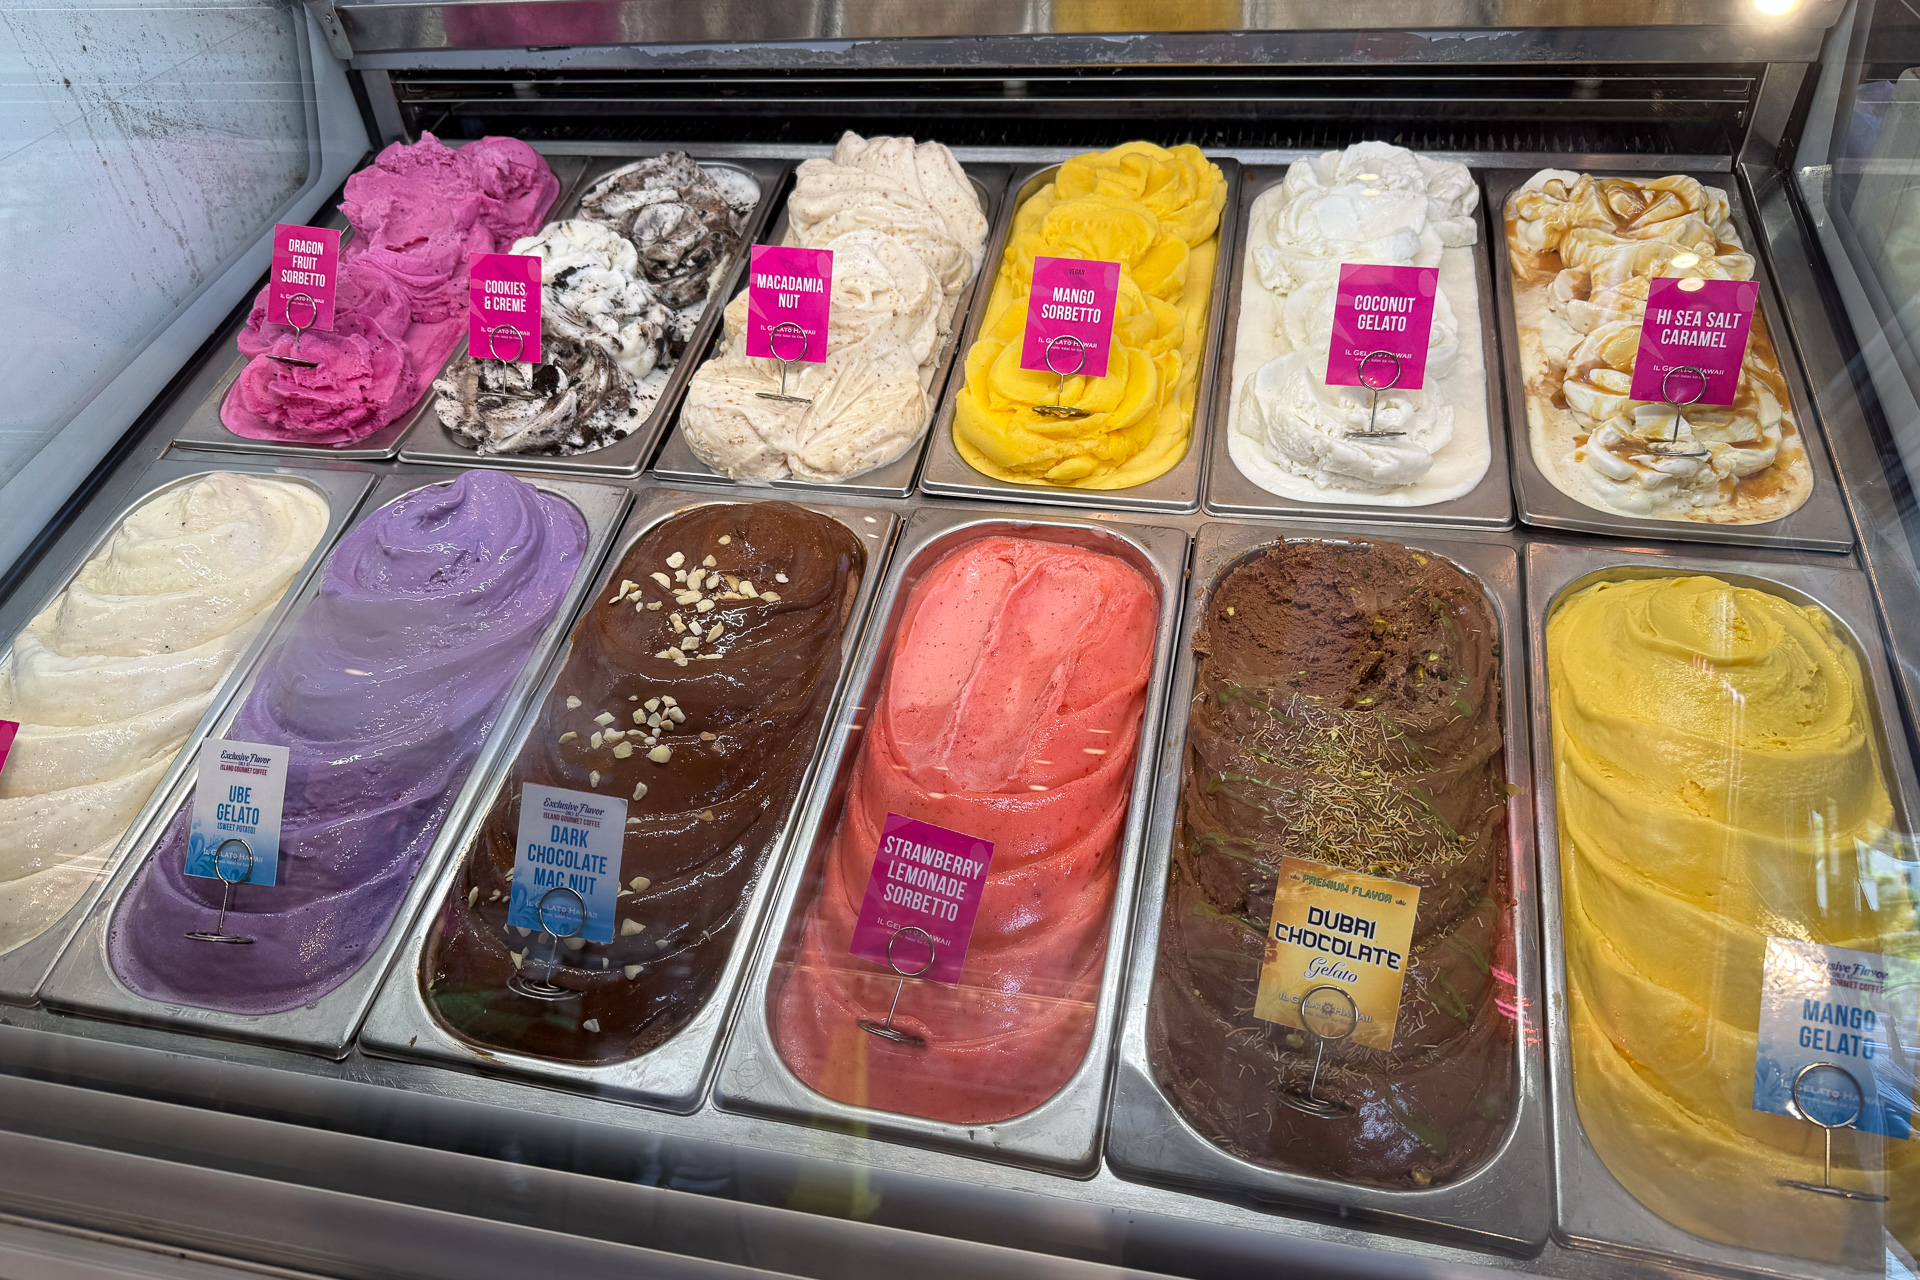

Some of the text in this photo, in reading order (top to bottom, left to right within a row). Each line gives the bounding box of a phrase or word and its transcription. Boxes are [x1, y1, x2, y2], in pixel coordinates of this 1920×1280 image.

[288, 238, 324, 256] DRAGON
[292, 254, 318, 270] FRUIT
[281, 270, 326, 287] SORBETTO
[1069, 268, 1086, 276] VEGAN
[485, 280, 526, 296] COOKIES
[757, 274, 824, 293] MACADAMIA
[484, 296, 526, 313] & CREME
[778, 293, 800, 309] NUT
[1052, 287, 1095, 305] MANGO
[1354, 295, 1416, 313] COCONUT
[1041, 304, 1101, 324] SORBETTO
[1357, 314, 1406, 332] GELATO
[1656, 309, 1742, 329] HI SEA SALT
[1661, 329, 1727, 348] CARAMEL
[220, 750, 271, 765] Exclusive Flavor
[229, 785, 252, 804] UBE
[216, 803, 260, 826] GELATO
[543, 797, 604, 816] Exclusive Flavor
[543, 812, 600, 828] ISLAND GOURMET COFFEE
[550, 825, 589, 848] DARK
[528, 844, 608, 874] CHOCOLATE
[884, 835, 984, 880] STRAWBERRY
[533, 867, 597, 895] MAC NUT
[887, 859, 967, 900] LEMONADE
[1302, 874, 1392, 904] PREMIUM FLAVOR
[883, 883, 959, 922] SORBETTO
[1307, 905, 1376, 940] DUBAI
[1275, 921, 1402, 970] CHOCOLATE
[1303, 956, 1358, 983] Gelato
[1280, 992, 1288, 1002] IL
[1803, 999, 1876, 1032] MANGO
[1799, 1026, 1875, 1060] GELATO
